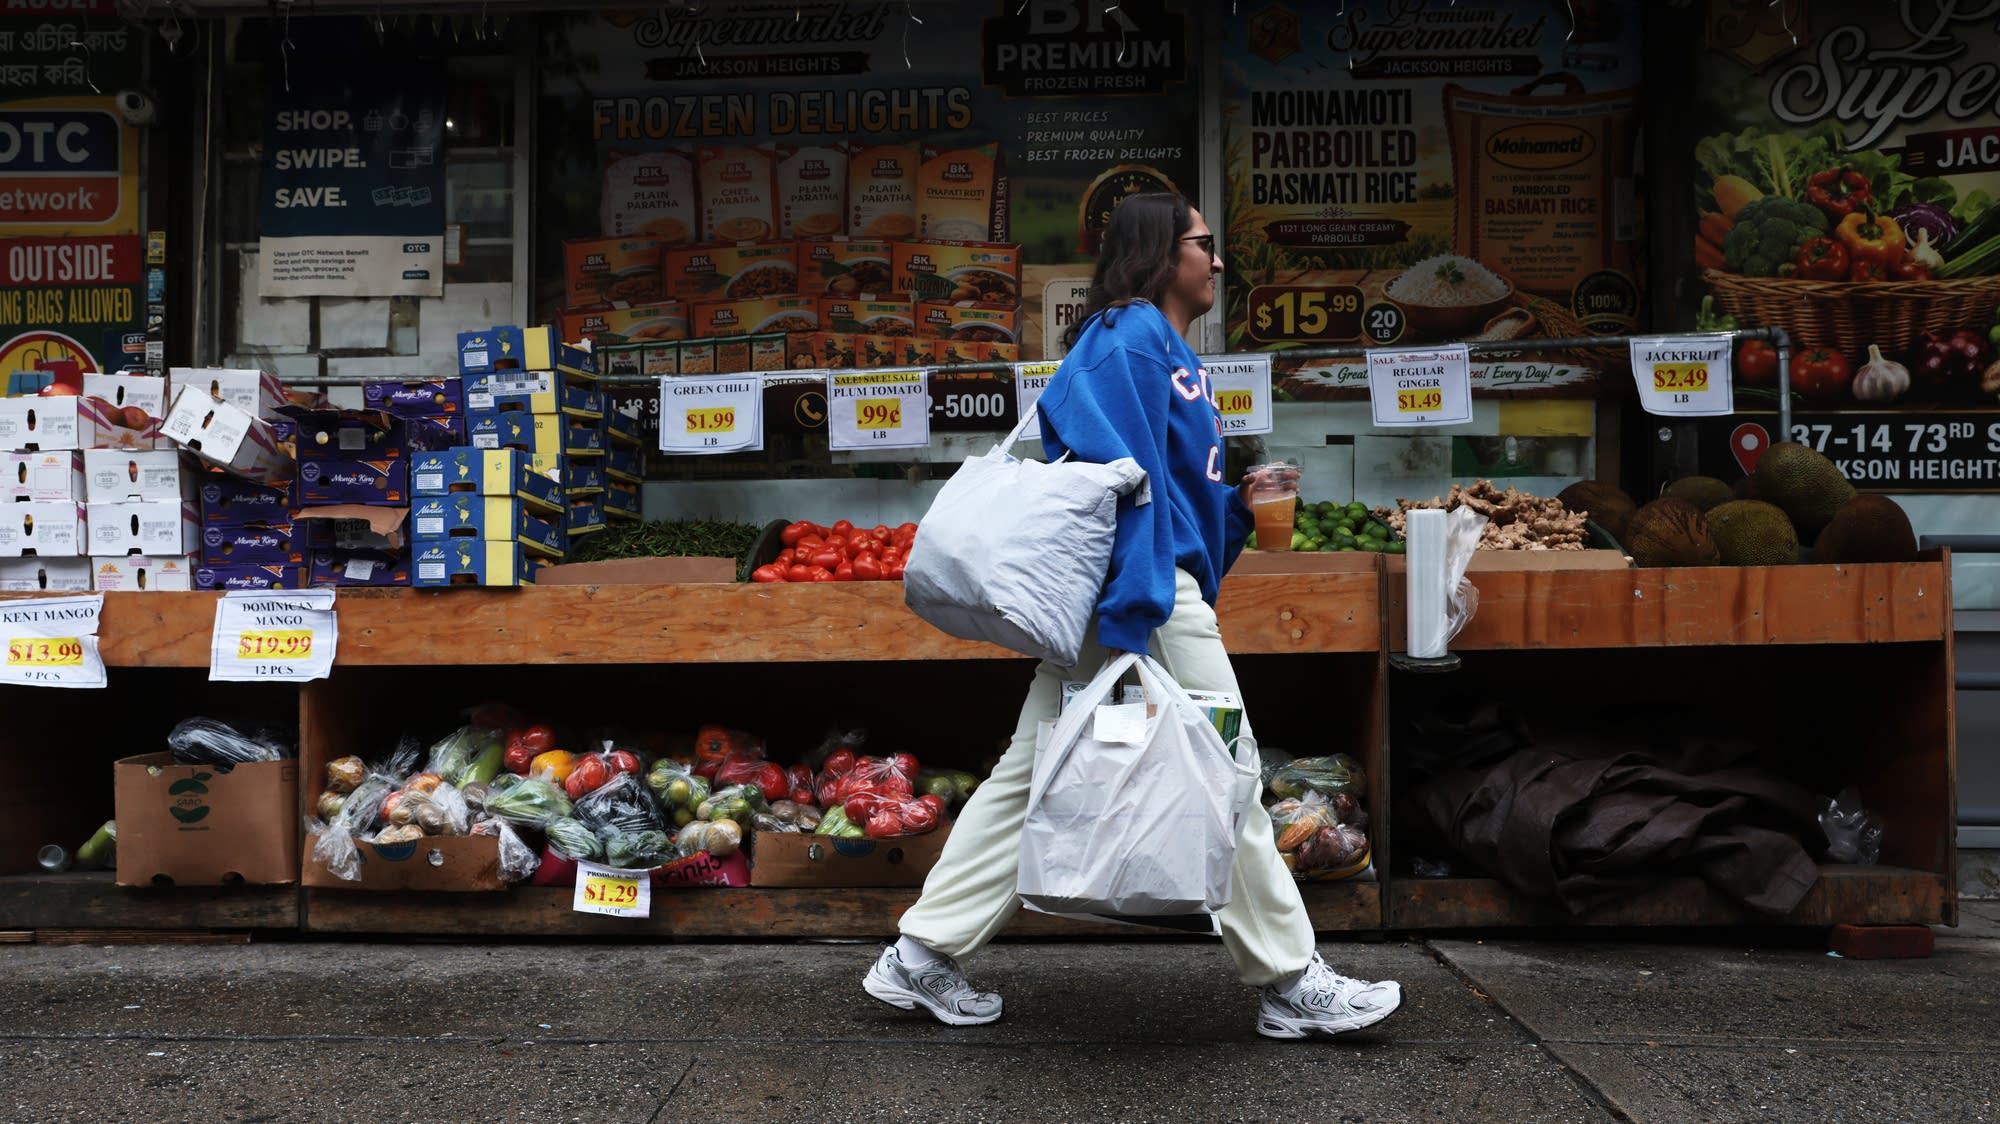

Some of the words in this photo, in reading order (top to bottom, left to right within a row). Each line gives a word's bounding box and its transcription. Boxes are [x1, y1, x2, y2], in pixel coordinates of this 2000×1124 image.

[1370, 0, 1496, 28] Premium
[635, 3, 886, 57] Supermarket
[1328, 9, 1546, 64] Supermarket
[995, 40, 1171, 71] PREMIUM
[675, 61, 760, 77] JACKSON
[766, 57, 841, 72] HEIGHTS
[1384, 60, 1449, 73] JACKSON
[1454, 59, 1513, 72] HEIGHTS
[1024, 76, 1089, 89] FROZEN
[1094, 75, 1146, 88] FRESH
[592, 94, 756, 141] FROZEN
[770, 87, 973, 135] DELIGHTS
[1251, 89, 1412, 126] MOINAMOTI
[276, 110, 354, 131] SHOP.
[1027, 112, 1059, 124] BEST
[1064, 111, 1108, 123] PRICES
[0, 121, 90, 164] OTC
[1027, 130, 1084, 142] PREMIUM
[1090, 129, 1144, 142] QUALITY
[1027, 149, 1060, 161] BEST
[1065, 149, 1116, 160] FROZEN
[1120, 147, 1182, 160] DELIGHTS
[1252, 129, 1416, 169] PARBOILED
[274, 148, 368, 170] SWIPE.
[799, 184, 831, 193] PLAIN
[869, 184, 902, 193] PLAIN
[1252, 172, 1357, 205] BASMATI
[1366, 171, 1417, 203] RICE
[274, 187, 348, 208] SAVE.
[634, 191, 669, 200] PLAIN
[791, 193, 839, 202] PARATHA
[862, 193, 913, 203] PARATHA
[627, 200, 679, 210] PARATHA
[1485, 199, 1556, 215] BASMATI
[1561, 198, 1598, 214] RICE
[1279, 224, 1297, 233] 1121
[1301, 224, 1327, 233] LONG
[1329, 224, 1357, 232] GRAIN
[1359, 223, 1396, 232] CREAMY
[1312, 234, 1365, 243] PARBOILED
[9, 243, 115, 282] OUTSIDE
[913, 255, 930, 265] BK
[26, 289, 64, 325] BAGS
[68, 288, 133, 324] ALLOWED
[1590, 294, 1622, 308] 100%
[717, 311, 732, 319] BK
[931, 310, 946, 318] BK
[1256, 291, 1358, 335] $15.99
[1371, 310, 1397, 328] 20
[586, 318, 602, 327] BK
[1377, 329, 1391, 339] LB
[1373, 357, 1395, 365] SALE
[1439, 353, 1462, 362] SALE
[1646, 350, 1720, 362] JACKFRUIT
[1227, 364, 1255, 374] LIME
[1337, 367, 1369, 383] Great
[1393, 366, 1444, 377] REGULAR
[1492, 367, 1522, 382] Every
[1525, 365, 1554, 382] Day!
[1398, 378, 1440, 389] GINGER
[1654, 368, 1708, 388] $2.49
[673, 385, 714, 396] GREEN
[716, 383, 750, 394] CHILI
[834, 386, 868, 398] PLUM
[871, 385, 922, 396] TOMATO
[1398, 392, 1442, 410] $1.49
[1674, 393, 1689, 403] LB
[687, 412, 735, 430] $1.99
[857, 404, 901, 427] .99¢
[704, 438, 718, 446] LB
[872, 431, 887, 439] LB
[1791, 424, 1892, 453] 37-14
[1904, 422, 1975, 453] 73RD
[234, 536, 262, 547] Mango
[262, 536, 278, 547] King
[226, 577, 252, 588] Mango
[252, 577, 269, 587] King
[242, 602, 314, 613] DOMINICAN
[3, 610, 40, 624] KENT
[45, 607, 94, 621] MANGO
[255, 615, 303, 626] MANGO
[9, 641, 82, 663] $13.99
[240, 635, 312, 657] $19.99
[25, 671, 32, 681] 9
[36, 671, 61, 681] PCS
[255, 666, 266, 675] 12
[270, 665, 294, 675] PCS
[585, 884, 638, 903] $1.29
